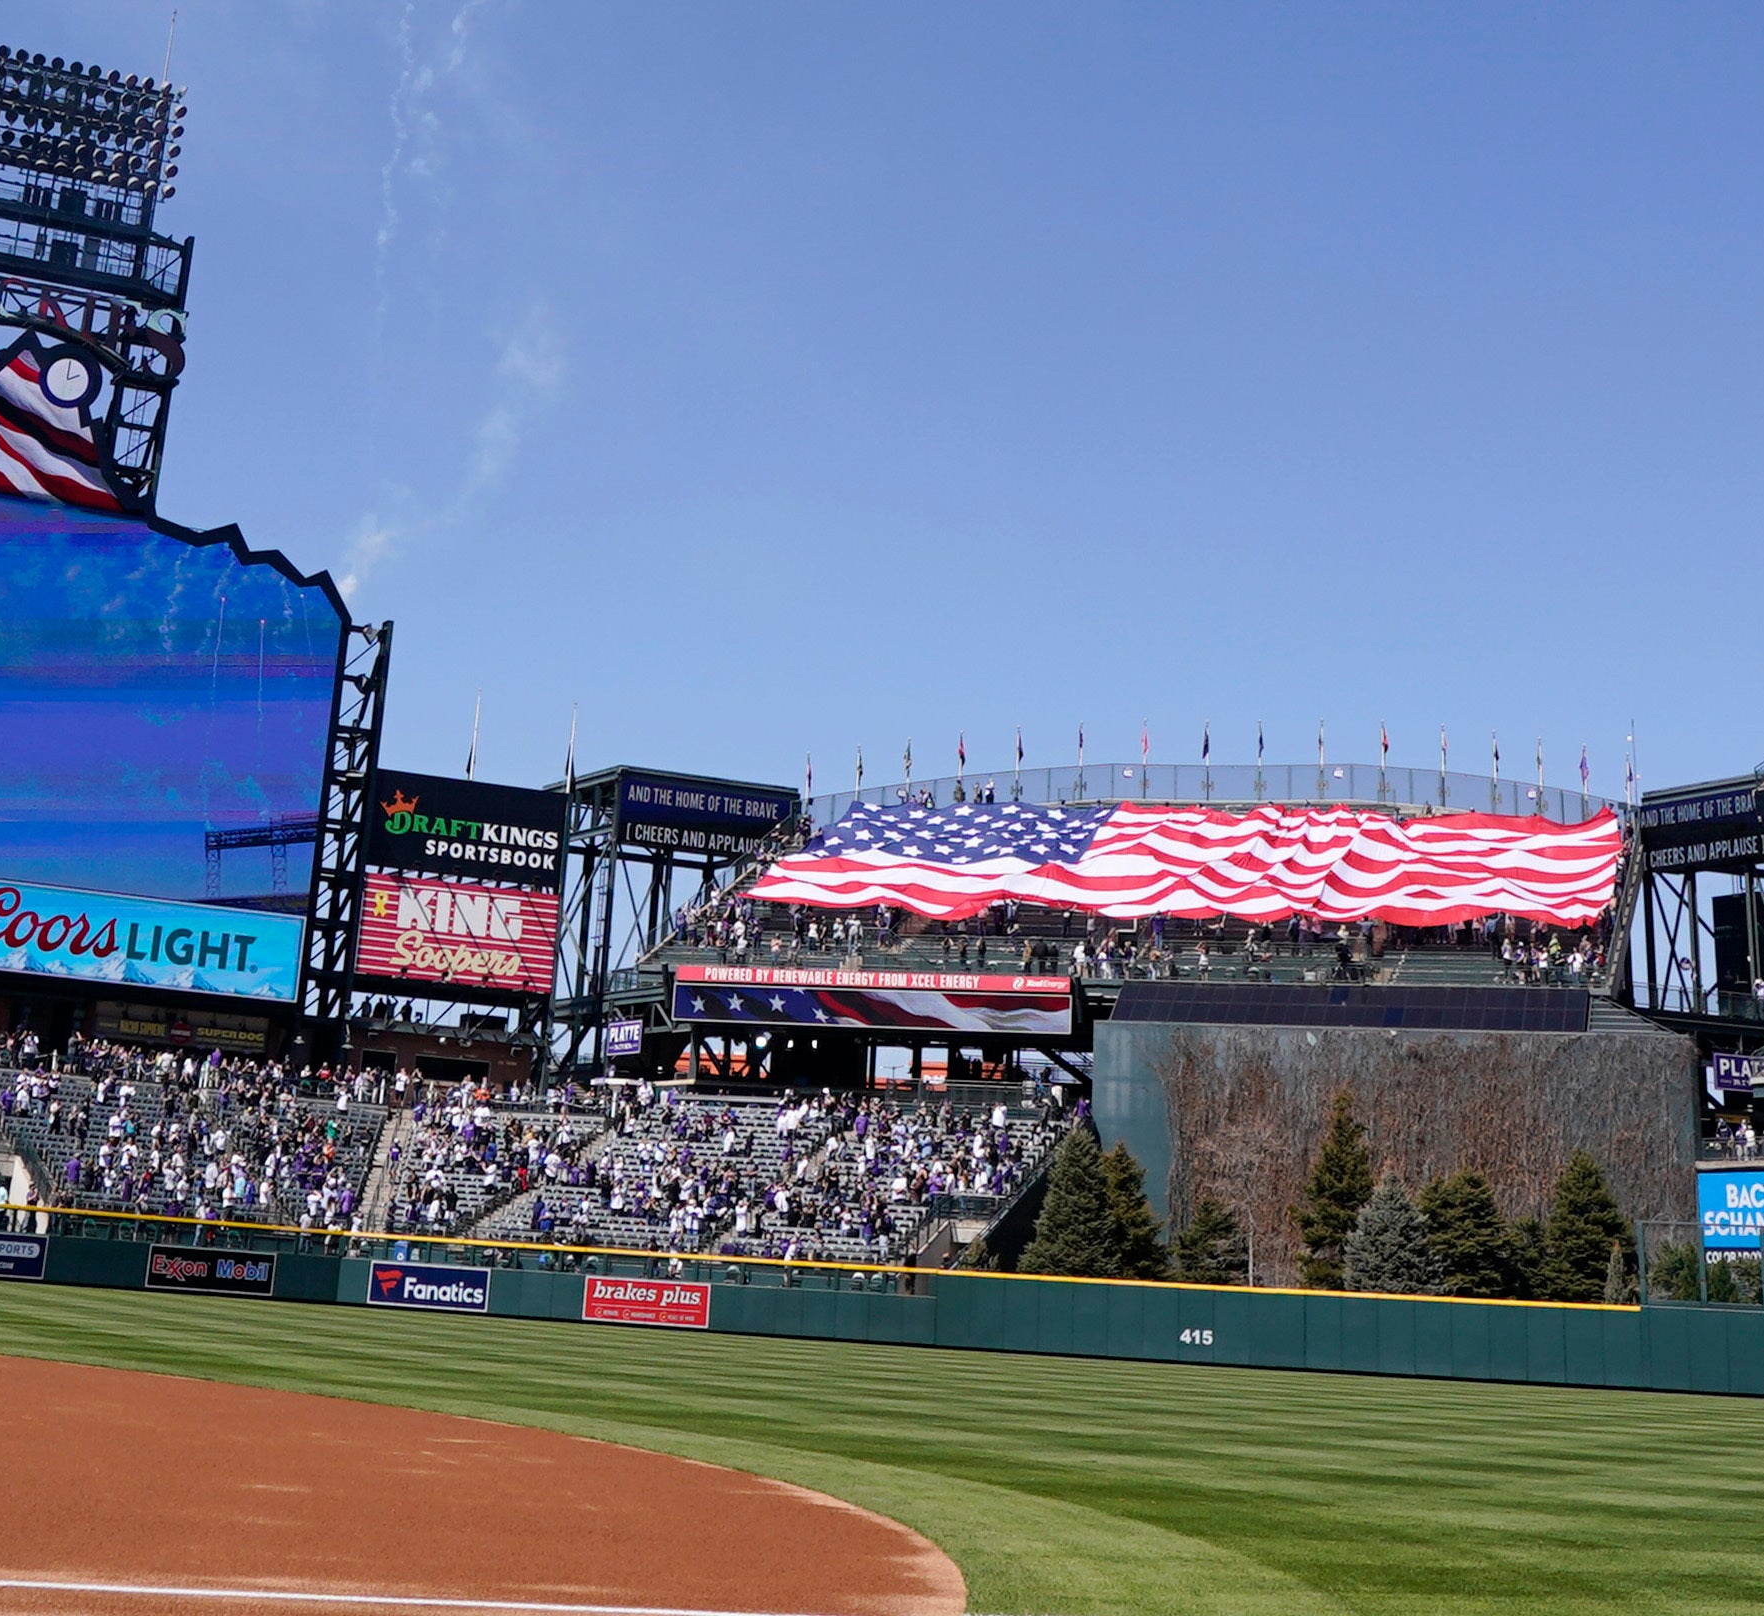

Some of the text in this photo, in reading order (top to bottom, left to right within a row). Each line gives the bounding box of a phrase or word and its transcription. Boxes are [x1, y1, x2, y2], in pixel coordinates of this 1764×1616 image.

[628, 784, 780, 820] AND THE HOME OF THE BRAVE
[1640, 809, 1659, 828] AND
[1660, 806, 1677, 826] THE
[1677, 802, 1702, 822] HOME
[1703, 800, 1715, 819] OF
[1716, 797, 1733, 816] THE
[384, 811, 559, 851] DRAFTKINGS
[634, 824, 679, 845] CHEERS
[681, 830, 706, 849] AND
[424, 839, 555, 870] SPORTSBOOK
[1649, 845, 1686, 868] CHEERS
[1687, 843, 1707, 863] AND
[1708, 835, 1759, 861] APPLAUSE
[396, 887, 523, 941] KING
[125, 922, 258, 973] LIGHT
[389, 930, 522, 982] Soopers
[704, 967, 753, 982] POWERED
[755, 969, 770, 982] BY
[773, 969, 833, 984] RENEWABLE
[836, 971, 875, 985] ENERGY
[878, 973, 908, 987] FROM
[910, 974, 936, 987] XCEL
[940, 975, 980, 989] ENERGY
[609, 1024, 640, 1043] PLATTE
[152, 1255, 269, 1282] Exxon Mobil
[403, 1277, 484, 1305] Fanatics
[592, 1281, 701, 1306] brakes plus
[1179, 1328, 1213, 1345] 415
